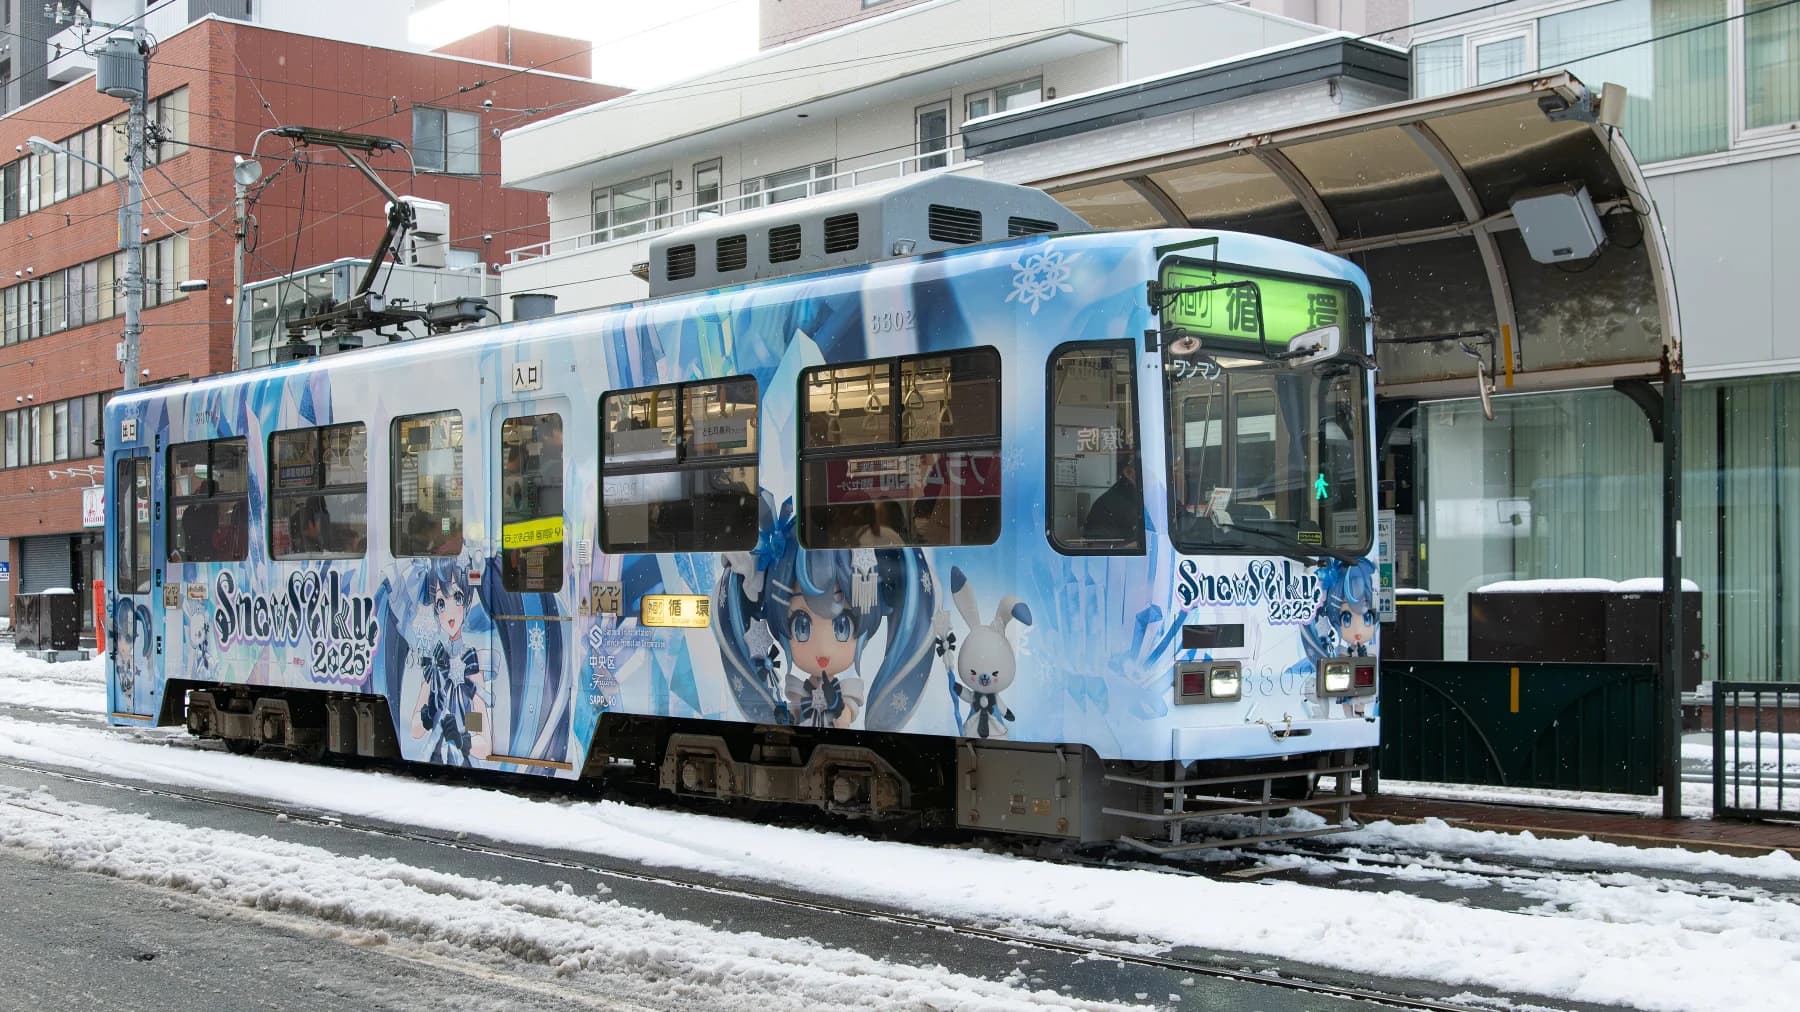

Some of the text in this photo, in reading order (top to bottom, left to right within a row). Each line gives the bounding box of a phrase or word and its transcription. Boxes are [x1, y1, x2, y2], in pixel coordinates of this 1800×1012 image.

[514, 365, 538, 385] 入口
[1174, 359, 1221, 381] ワンマン
[592, 585, 621, 597] ワンマン
[595, 599, 618, 612] 入口
[1269, 601, 1312, 621] 2025
[312, 641, 367, 676] 2025
[589, 655, 616, 669] 中央区
